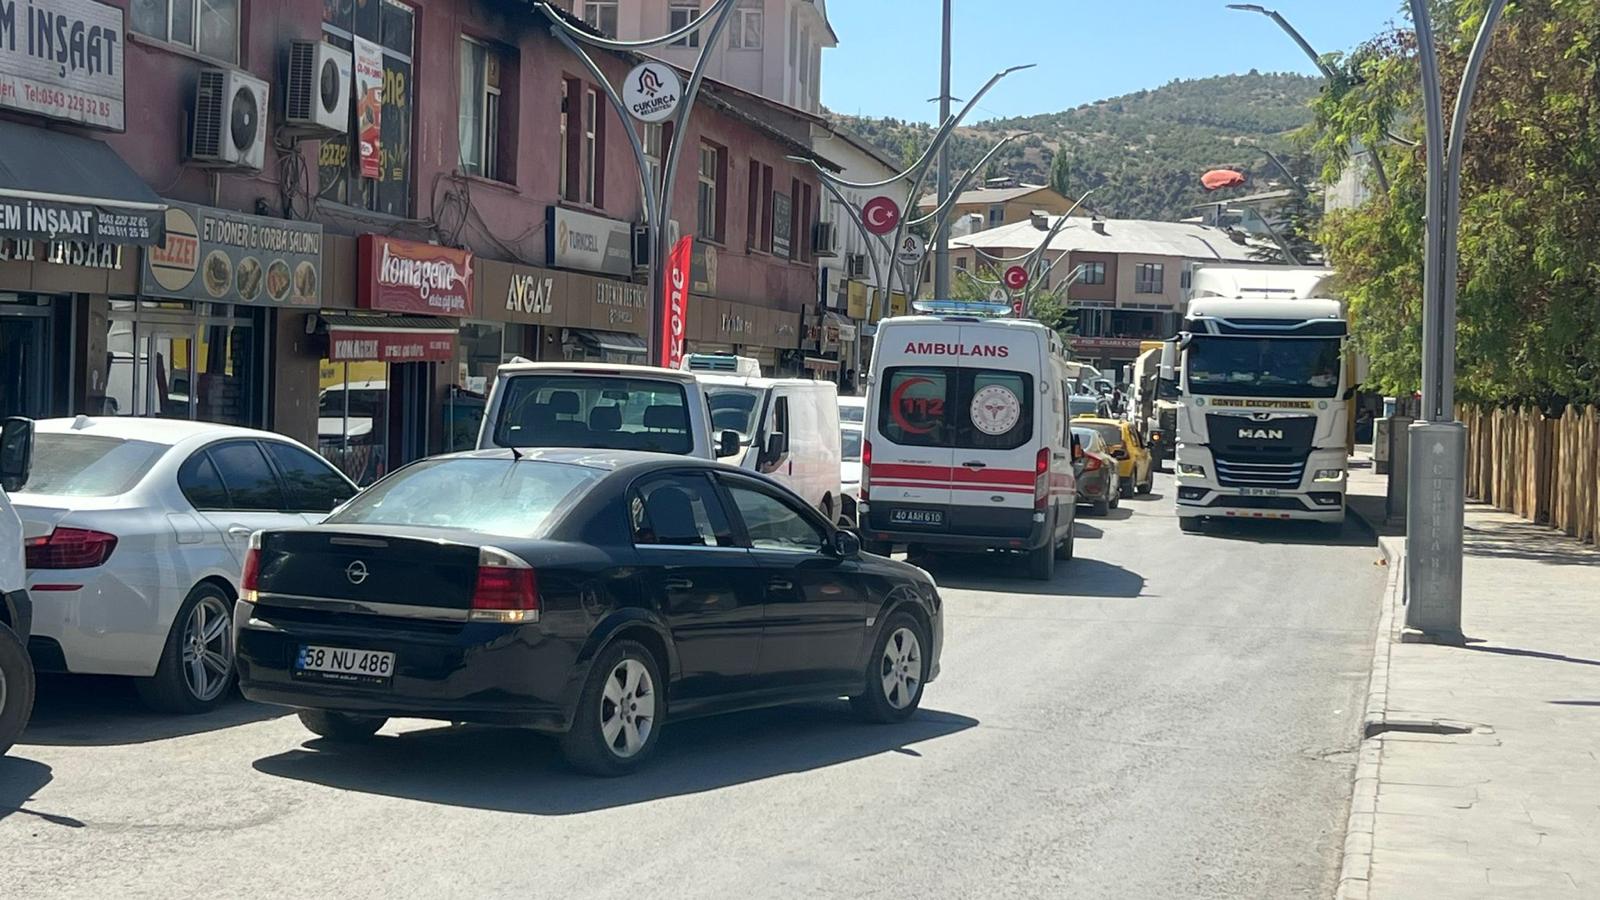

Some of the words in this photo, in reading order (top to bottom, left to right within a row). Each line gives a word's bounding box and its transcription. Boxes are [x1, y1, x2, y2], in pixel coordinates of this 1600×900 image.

[28, 0, 117, 78] İNŞAAT
[0, 82, 15, 98] eri
[24, 84, 65, 107] Tel:0543
[67, 94, 84, 112] 229
[86, 98, 97, 115] 32
[27, 201, 93, 239] İNŞAAT
[204, 218, 215, 241] ET
[218, 216, 248, 248] DÖNER
[251, 226, 257, 247] &
[569, 230, 598, 252] TURKCELL
[381, 243, 457, 299] komagene
[506, 274, 553, 314] AYGAZ
[904, 342, 1009, 358] AMBULANS
[903, 397, 945, 417] 112
[1238, 429, 1283, 439] MAN
[896, 511, 906, 520] 40
[907, 511, 924, 521] AAH
[925, 512, 941, 522] 610
[306, 649, 325, 667] 58
[331, 651, 356, 670] NU
[359, 653, 390, 673] 486
